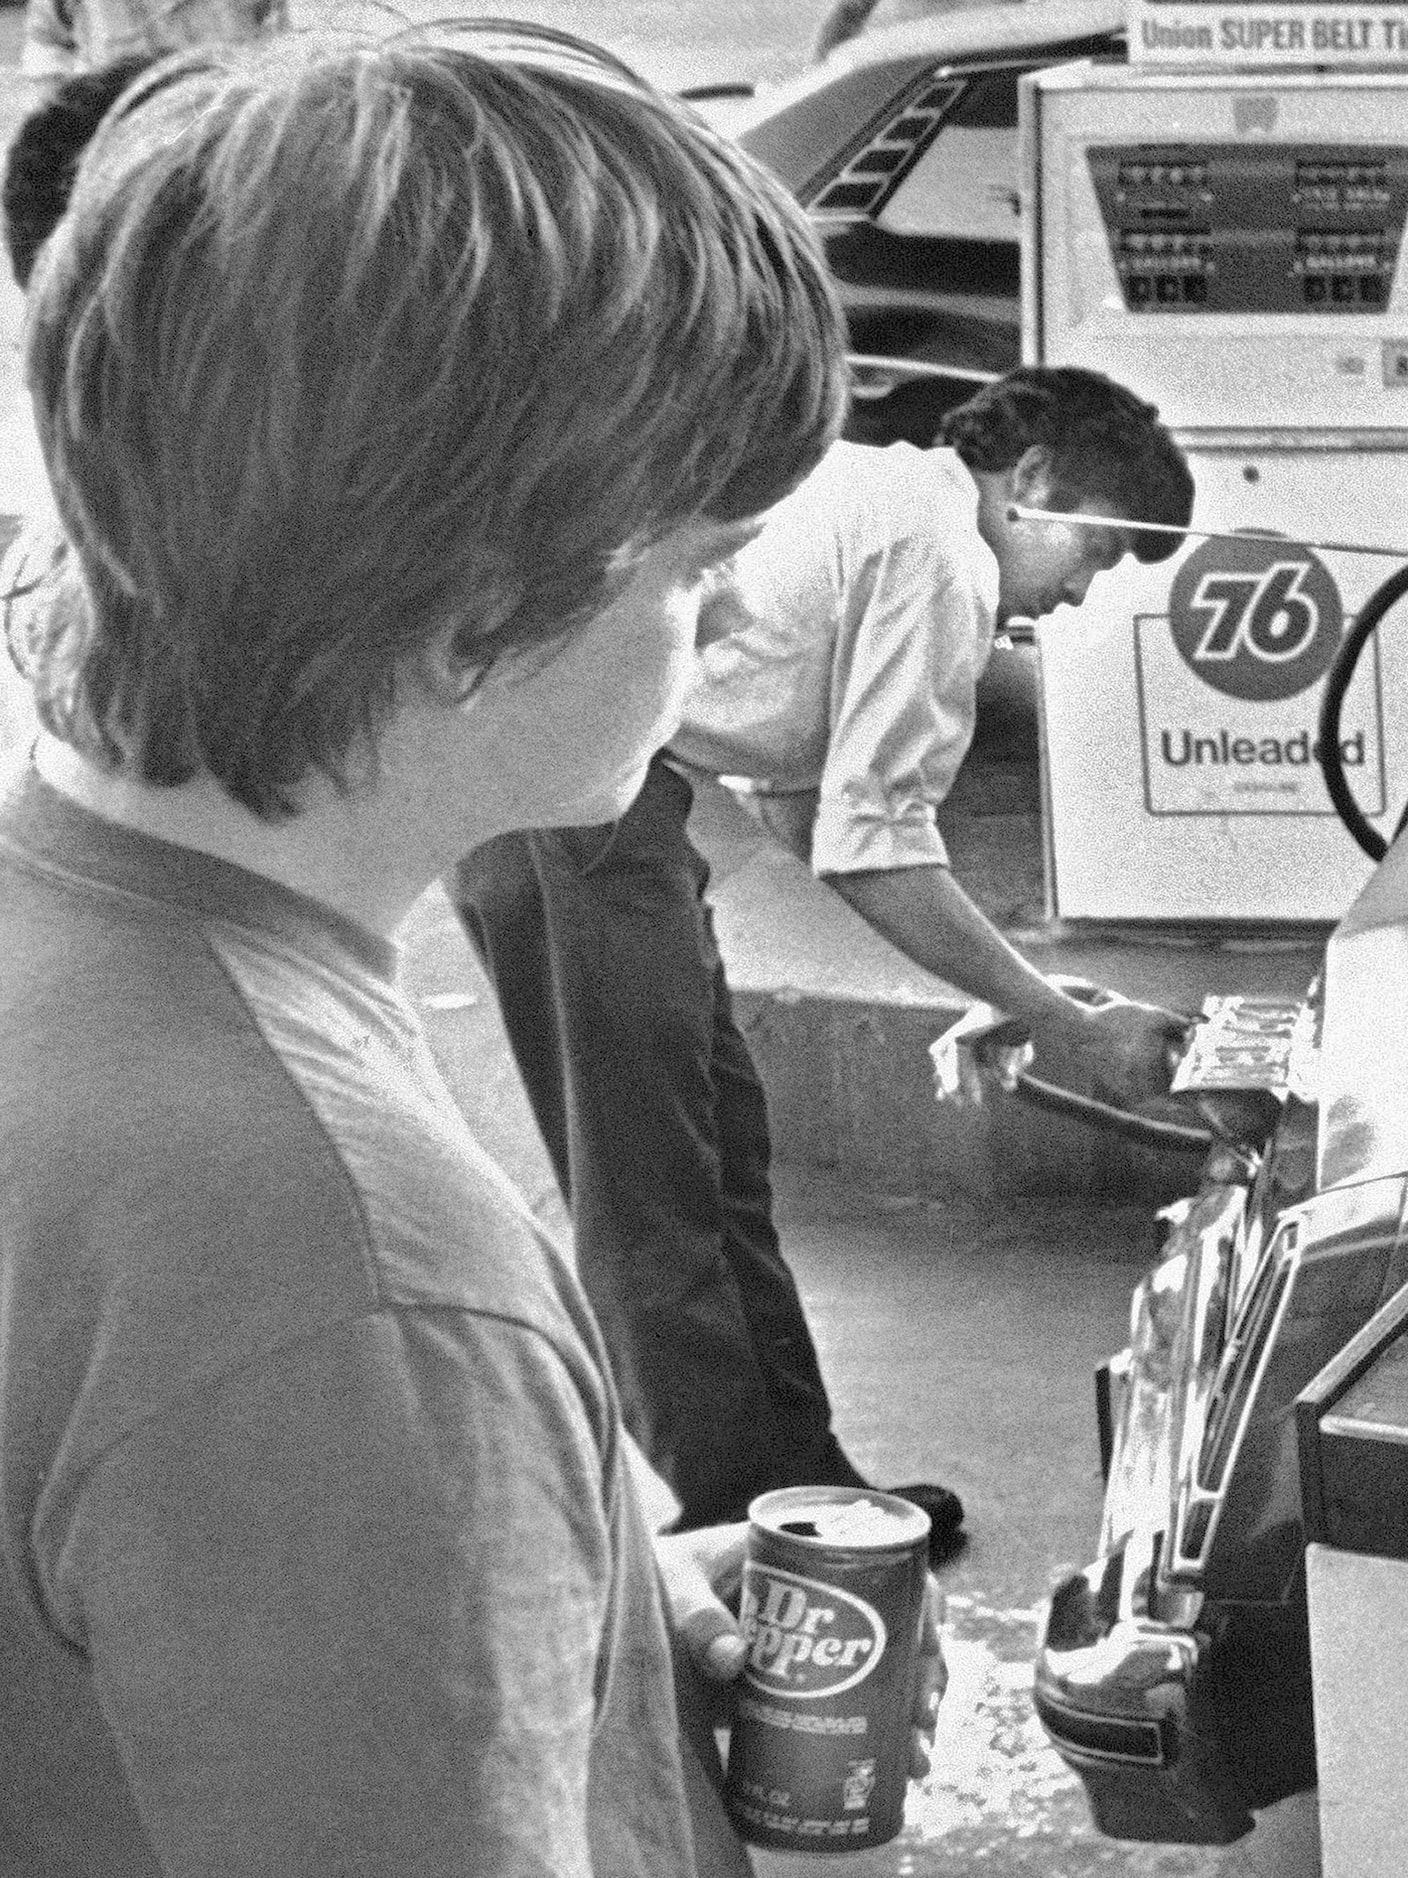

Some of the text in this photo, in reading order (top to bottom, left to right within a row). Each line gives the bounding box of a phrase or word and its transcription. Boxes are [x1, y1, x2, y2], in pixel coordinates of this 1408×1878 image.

[1141, 19, 1213, 49] Union
[1220, 18, 1304, 50] SUPER
[1311, 18, 1373, 50] BELT
[1190, 560, 1320, 663] 76
[757, 1579, 836, 1634] Dr
